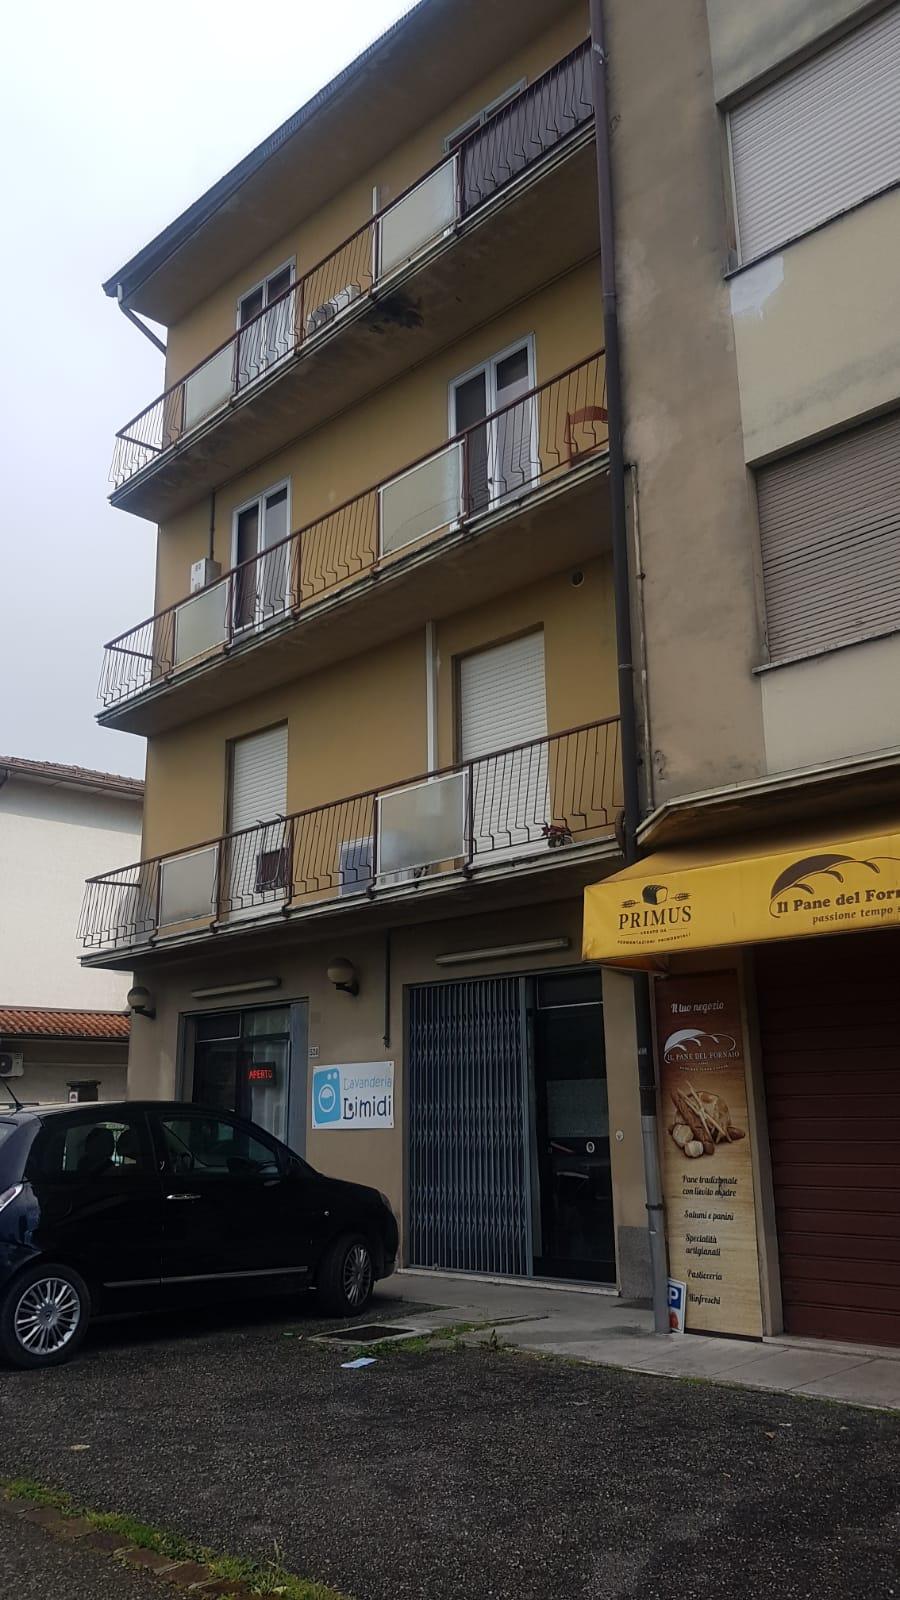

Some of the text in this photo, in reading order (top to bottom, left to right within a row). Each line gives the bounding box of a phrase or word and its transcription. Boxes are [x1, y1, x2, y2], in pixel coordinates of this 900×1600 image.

[776, 901, 788, 913] Il
[793, 898, 830, 911] Pane
[835, 891, 860, 906] del
[618, 906, 691, 930] PRIMUS
[812, 911, 856, 925] passione
[860, 906, 893, 918] tempo
[671, 1000, 724, 1014] Il tuo negozio
[676, 1053, 693, 1061] PANE
[695, 1052, 707, 1060] DEL
[709, 1051, 740, 1059] FORNAIO
[248, 1069, 273, 1080] APERTO
[344, 1076, 392, 1090] Lavanderia
[682, 1175, 698, 1184] Pane
[682, 1187, 693, 1195] con
[694, 1187, 714, 1196] lievito
[684, 1209, 707, 1219] Salumi
[712, 1212, 734, 1222] panini
[685, 1246, 721, 1257] artigianali
[687, 1269, 723, 1280] Pasticceria
[669, 1287, 679, 1304] P
[688, 1293, 721, 1305] Rinfreschi
